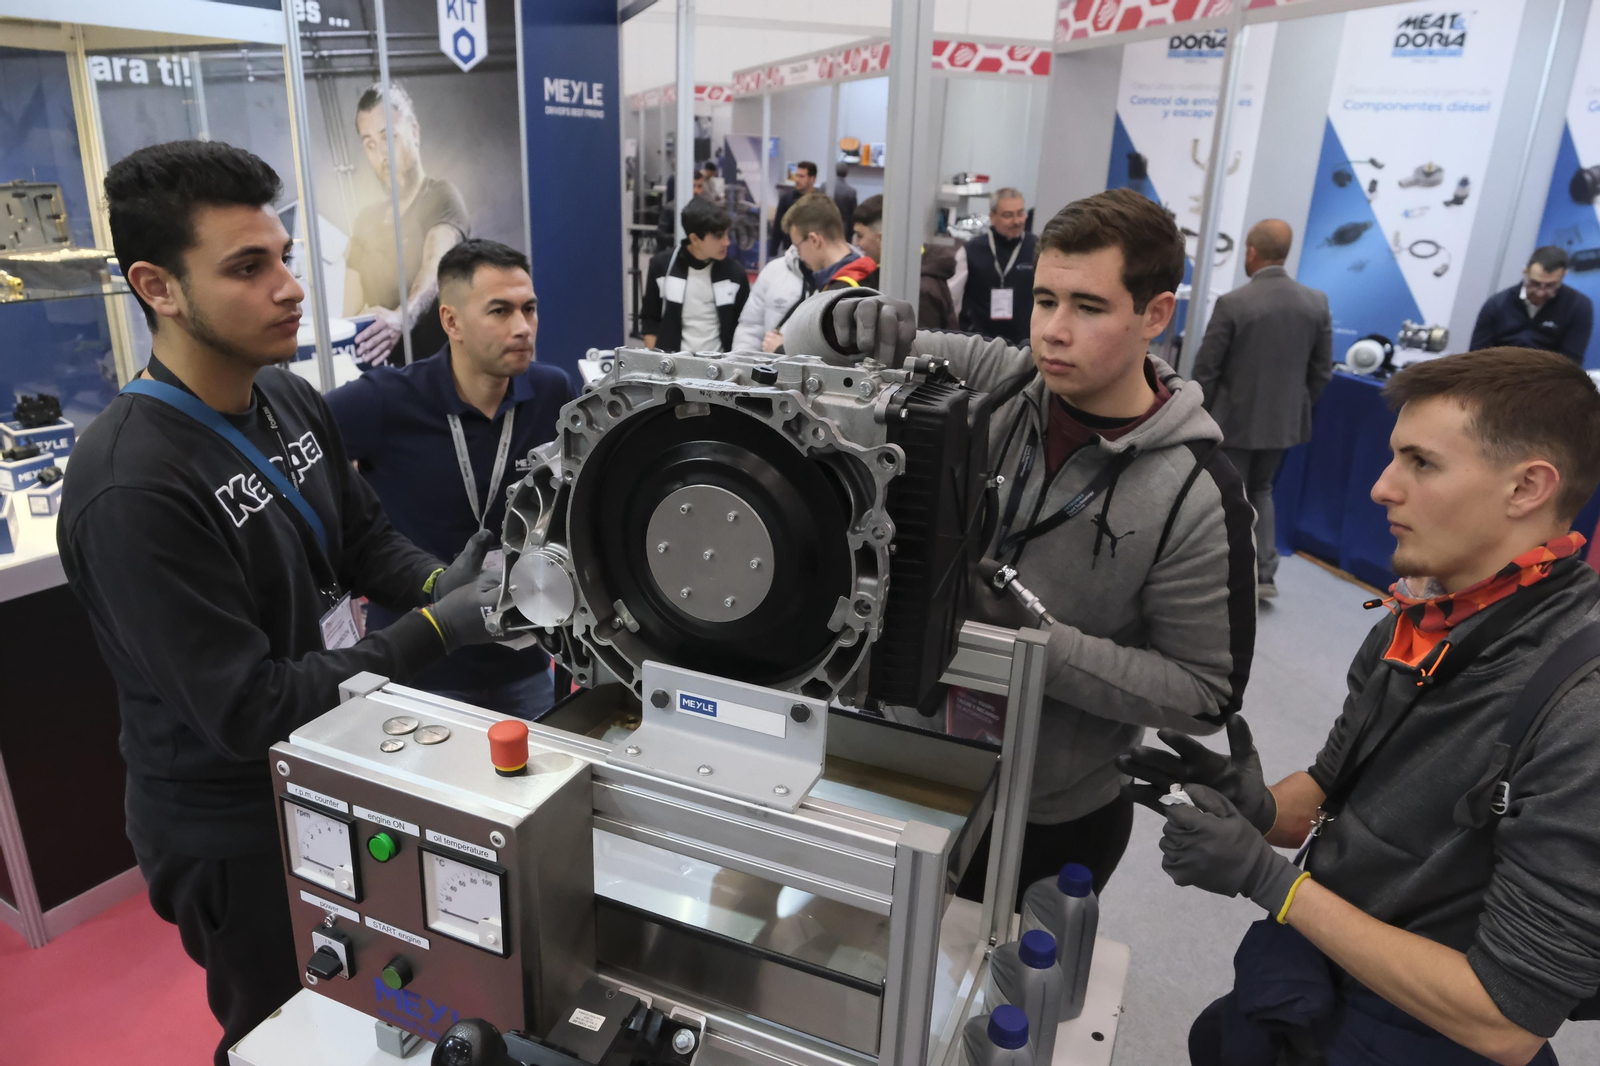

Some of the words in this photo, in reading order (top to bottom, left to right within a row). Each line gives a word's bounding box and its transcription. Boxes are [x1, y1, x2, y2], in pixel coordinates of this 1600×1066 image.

[446, 0, 477, 23] KIT
[1395, 32, 1466, 47] DORIA
[87, 55, 149, 84] ara
[157, 55, 192, 87] ti!
[544, 77, 604, 106] MEYLE
[1130, 95, 1171, 105] Control
[1343, 99, 1441, 112] Componentes
[1172, 109, 1213, 118] escape
[36, 438, 69, 453] EYLE
[18, 467, 46, 483] MEY
[215, 431, 323, 527] Kapa
[682, 698, 714, 713] MEYLE
[315, 795, 340, 808] counter
[296, 808, 311, 819] rpm
[367, 813, 391, 826] engine
[392, 821, 405, 830] ON
[433, 834, 442, 843] oil
[443, 836, 489, 858] temperature
[458, 880, 466, 888] 60
[481, 878, 493, 887] 100
[320, 901, 339, 914] power
[372, 921, 396, 935] START
[398, 932, 422, 946] engine
[374, 976, 459, 1025] MEY
